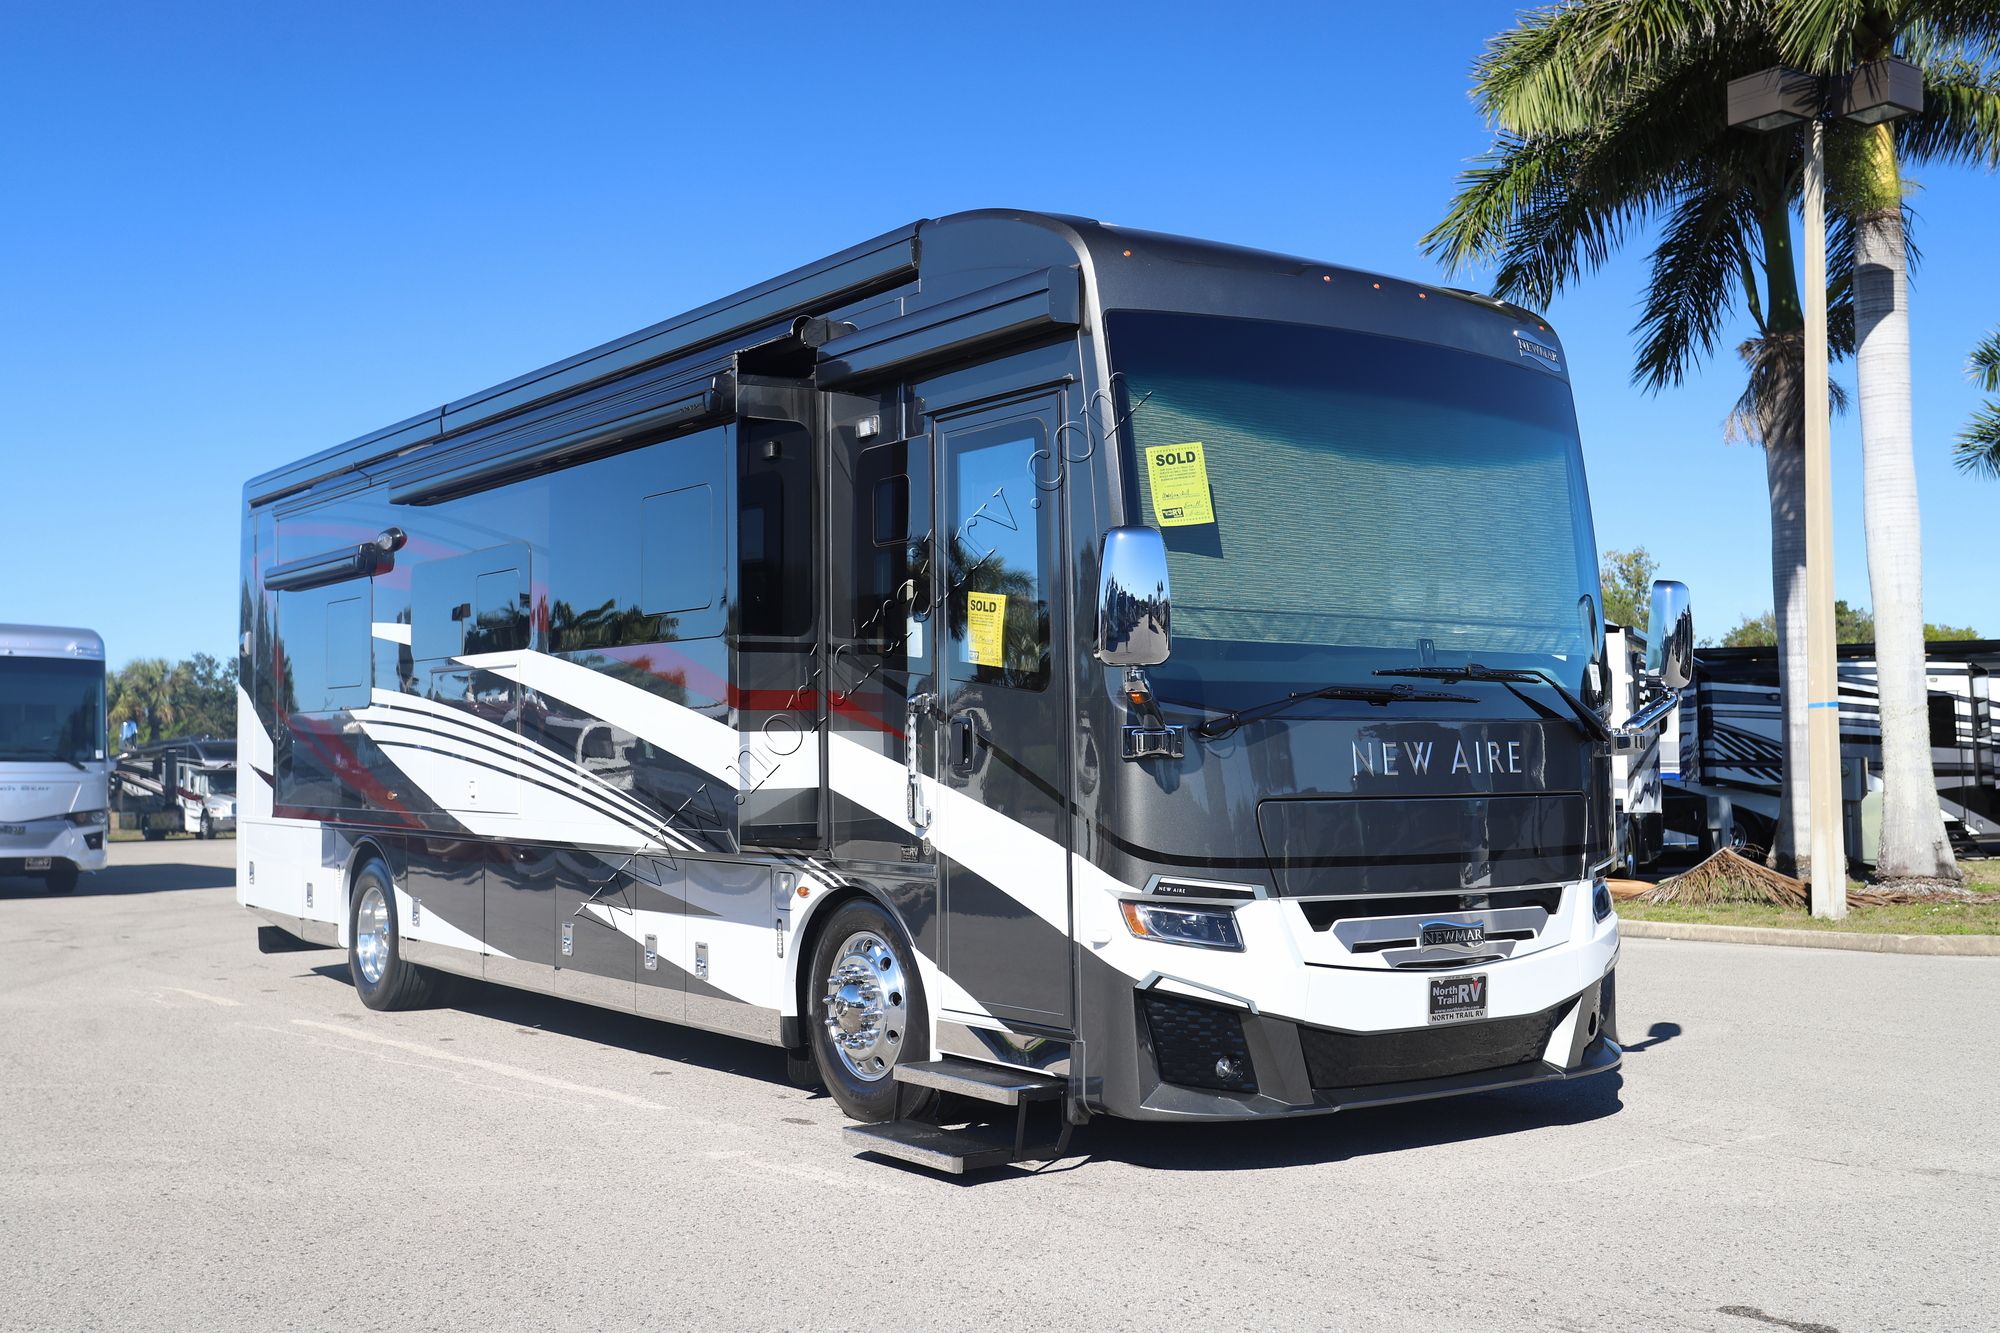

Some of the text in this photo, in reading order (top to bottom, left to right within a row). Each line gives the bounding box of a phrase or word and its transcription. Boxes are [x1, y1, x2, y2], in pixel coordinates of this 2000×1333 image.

[1518, 339, 1559, 363] NEWMAR
[1155, 451, 1196, 466] SOLD
[970, 599, 997, 613] SOLD
[1352, 740, 1522, 776] NEW AIRE
[1424, 929, 1483, 944] NEWMAR
[1433, 986, 1457, 996] North
[1458, 983, 1482, 1003] RV
[1437, 995, 1457, 1005] Trail
[1431, 1013, 1454, 1021] NORTH
[1455, 1011, 1474, 1019] TRAIL
